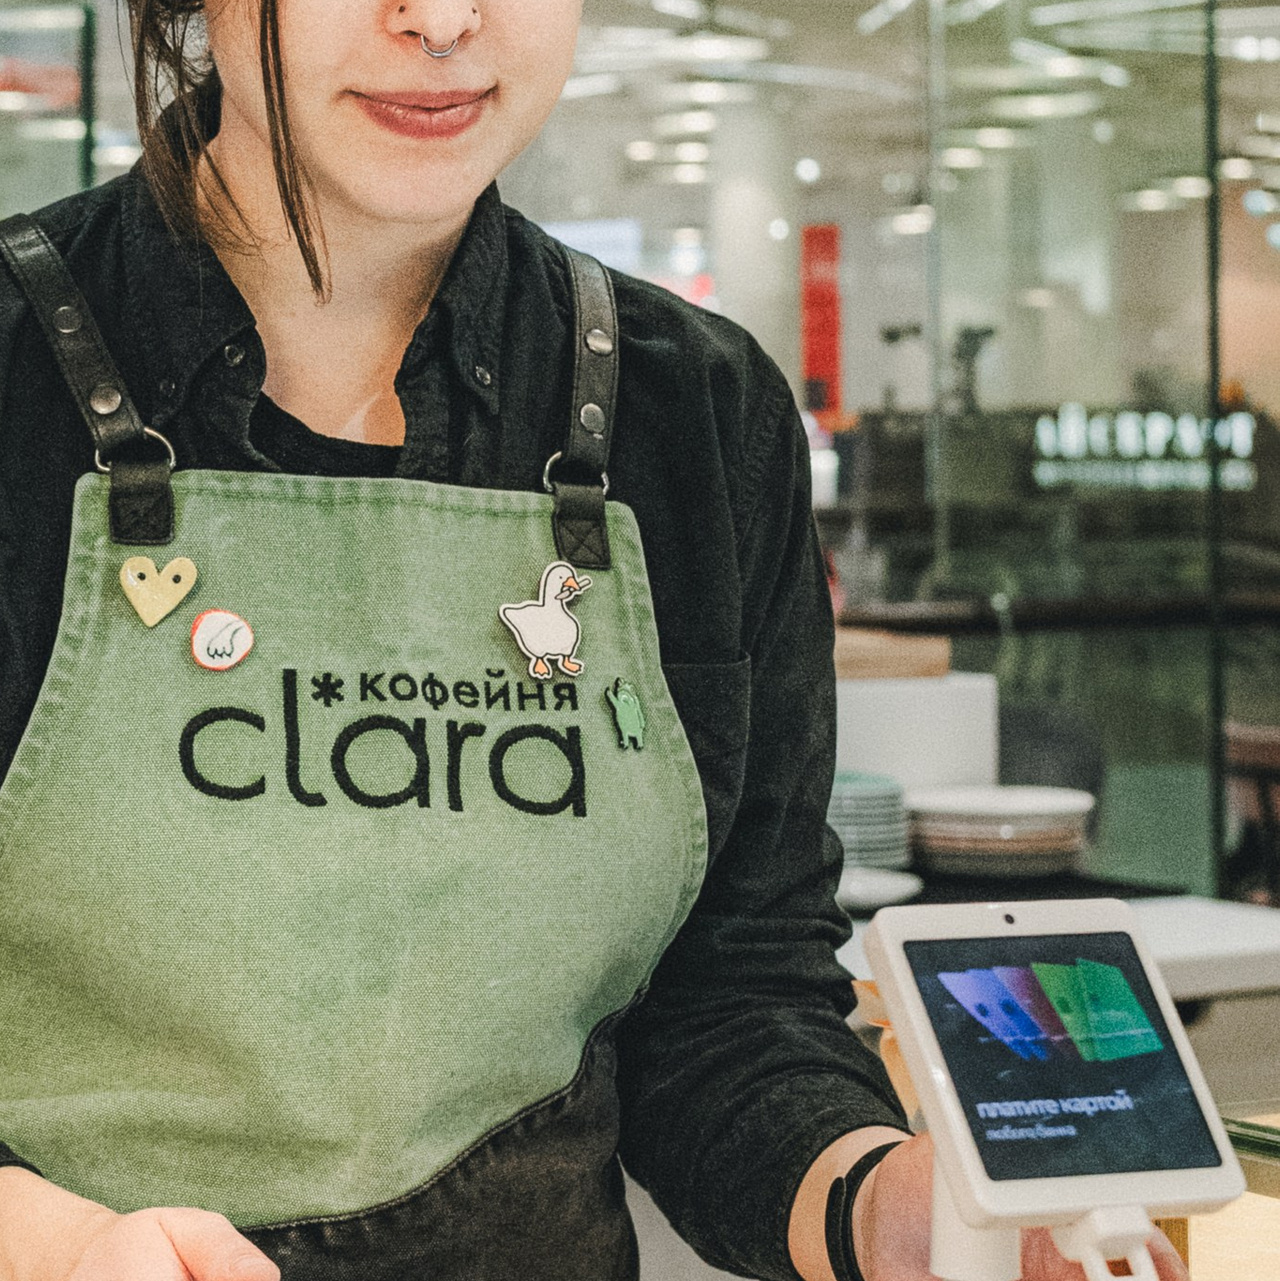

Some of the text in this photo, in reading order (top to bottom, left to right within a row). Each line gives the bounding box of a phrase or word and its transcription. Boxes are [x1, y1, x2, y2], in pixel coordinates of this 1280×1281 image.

[359, 667, 580, 712] кофейня
[177, 667, 587, 818] clara
[977, 1089, 1133, 1119] платите картой
